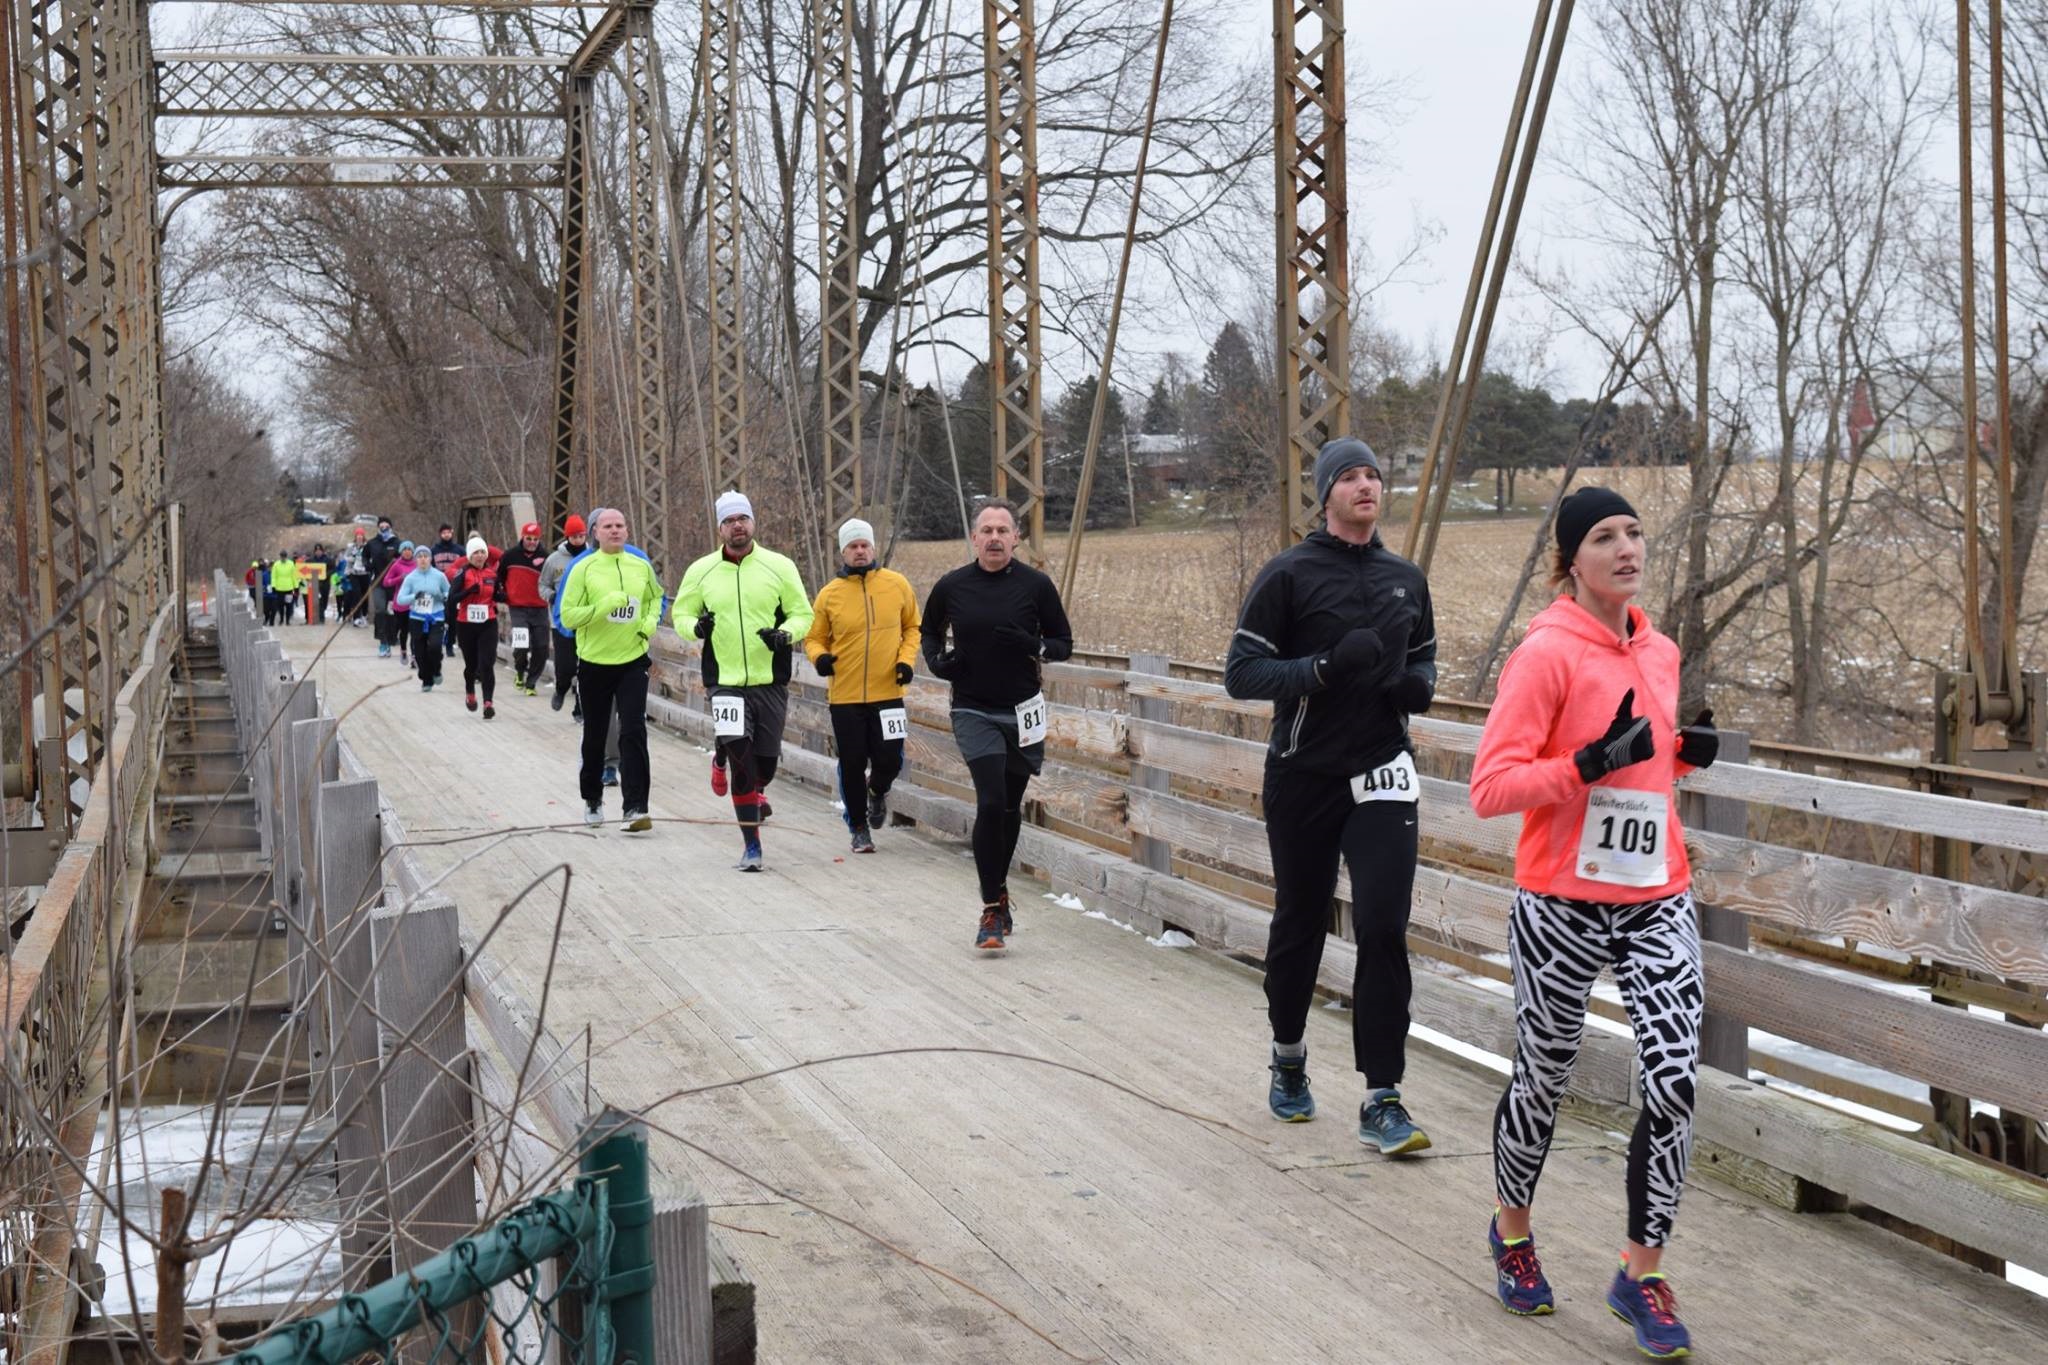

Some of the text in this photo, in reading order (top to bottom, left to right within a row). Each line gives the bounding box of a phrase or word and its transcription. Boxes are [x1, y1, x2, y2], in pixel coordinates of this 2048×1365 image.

[713, 707, 738, 722] 340
[1363, 766, 1410, 791] 403
[1597, 815, 1658, 855] 109
